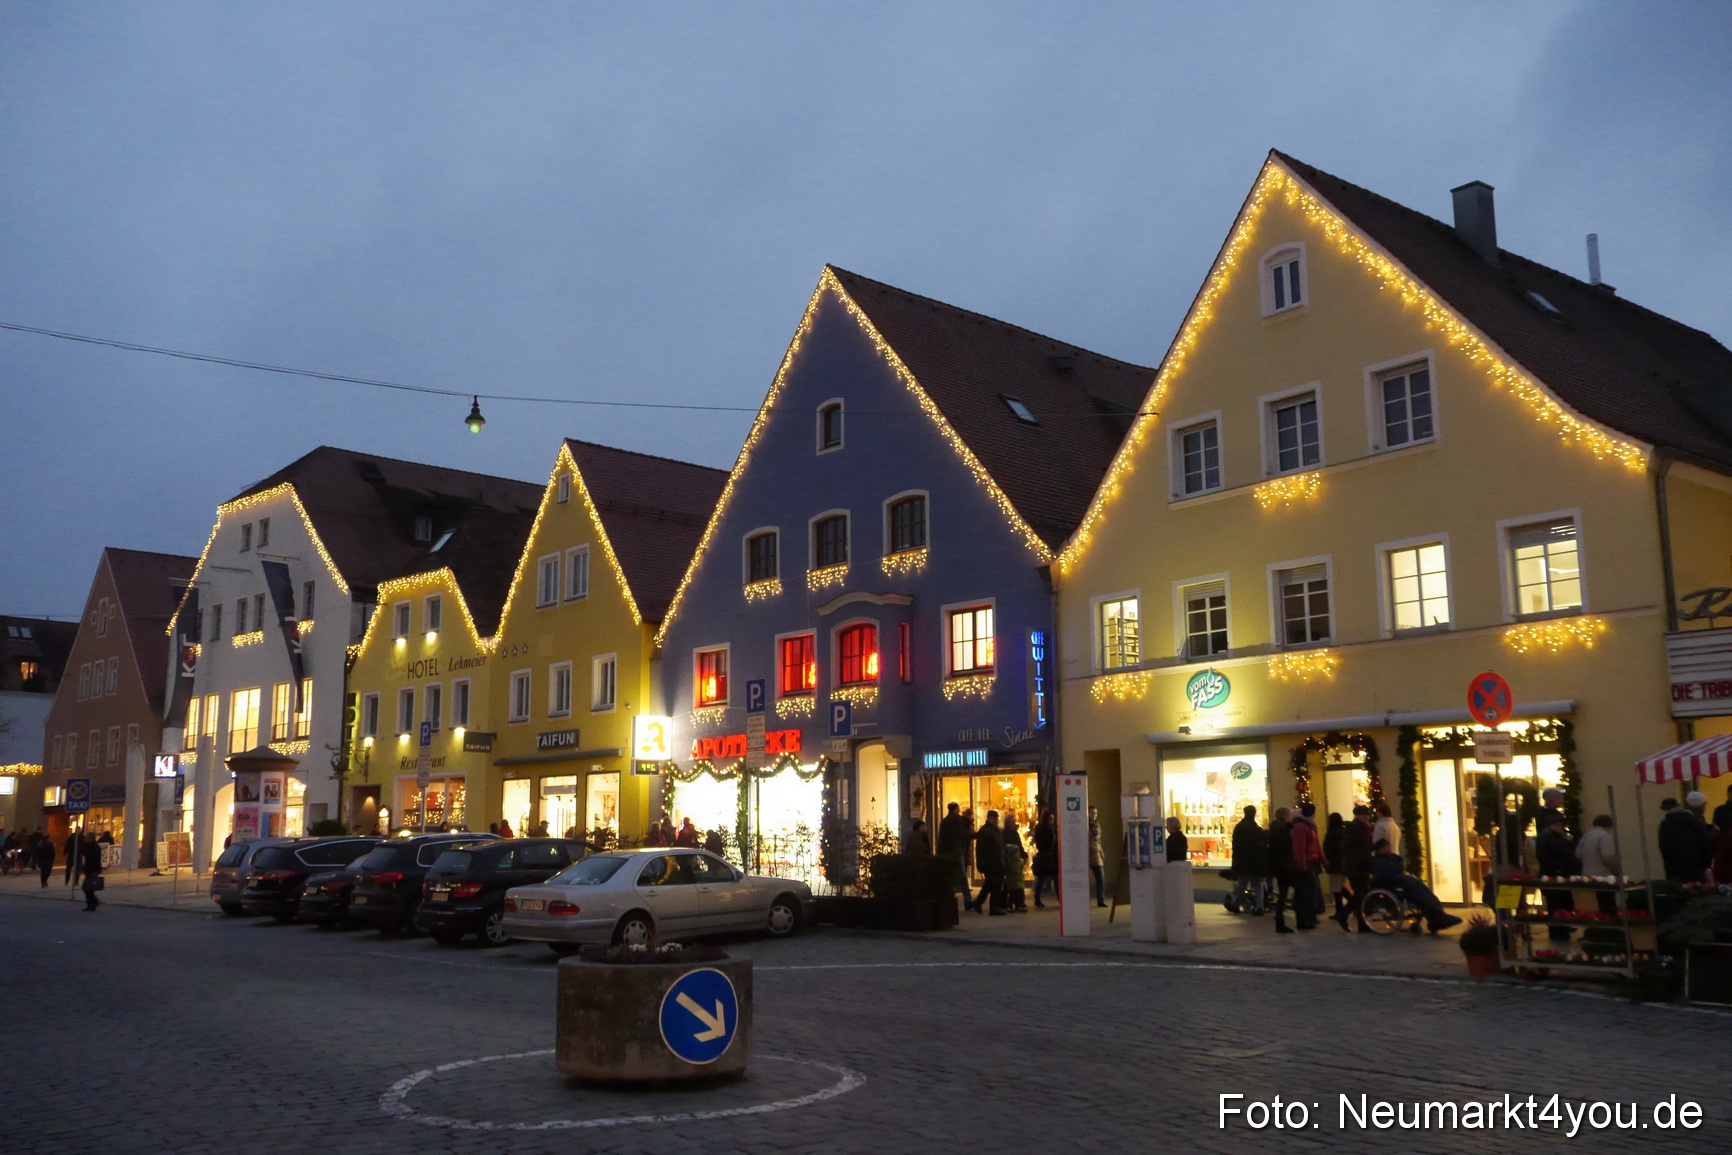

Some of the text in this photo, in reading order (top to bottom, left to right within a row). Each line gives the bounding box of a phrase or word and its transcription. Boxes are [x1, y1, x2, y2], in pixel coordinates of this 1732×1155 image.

[407, 656, 487, 680] HOTEL Lehmeier
[1032, 646, 1046, 722] WITTL
[1189, 676, 1209, 694] vom
[1190, 676, 1224, 711] FASS
[1671, 683, 1694, 701] DIE
[750, 683, 761, 709] P
[834, 705, 846, 732] P
[421, 725, 429, 745] P
[536, 732, 575, 748] TAIFUN
[688, 729, 802, 760] APOTKE
[924, 750, 987, 768] KONDITOREI WITTL
[68, 801, 88, 809] TAXI
[1155, 829, 1162, 842] P
